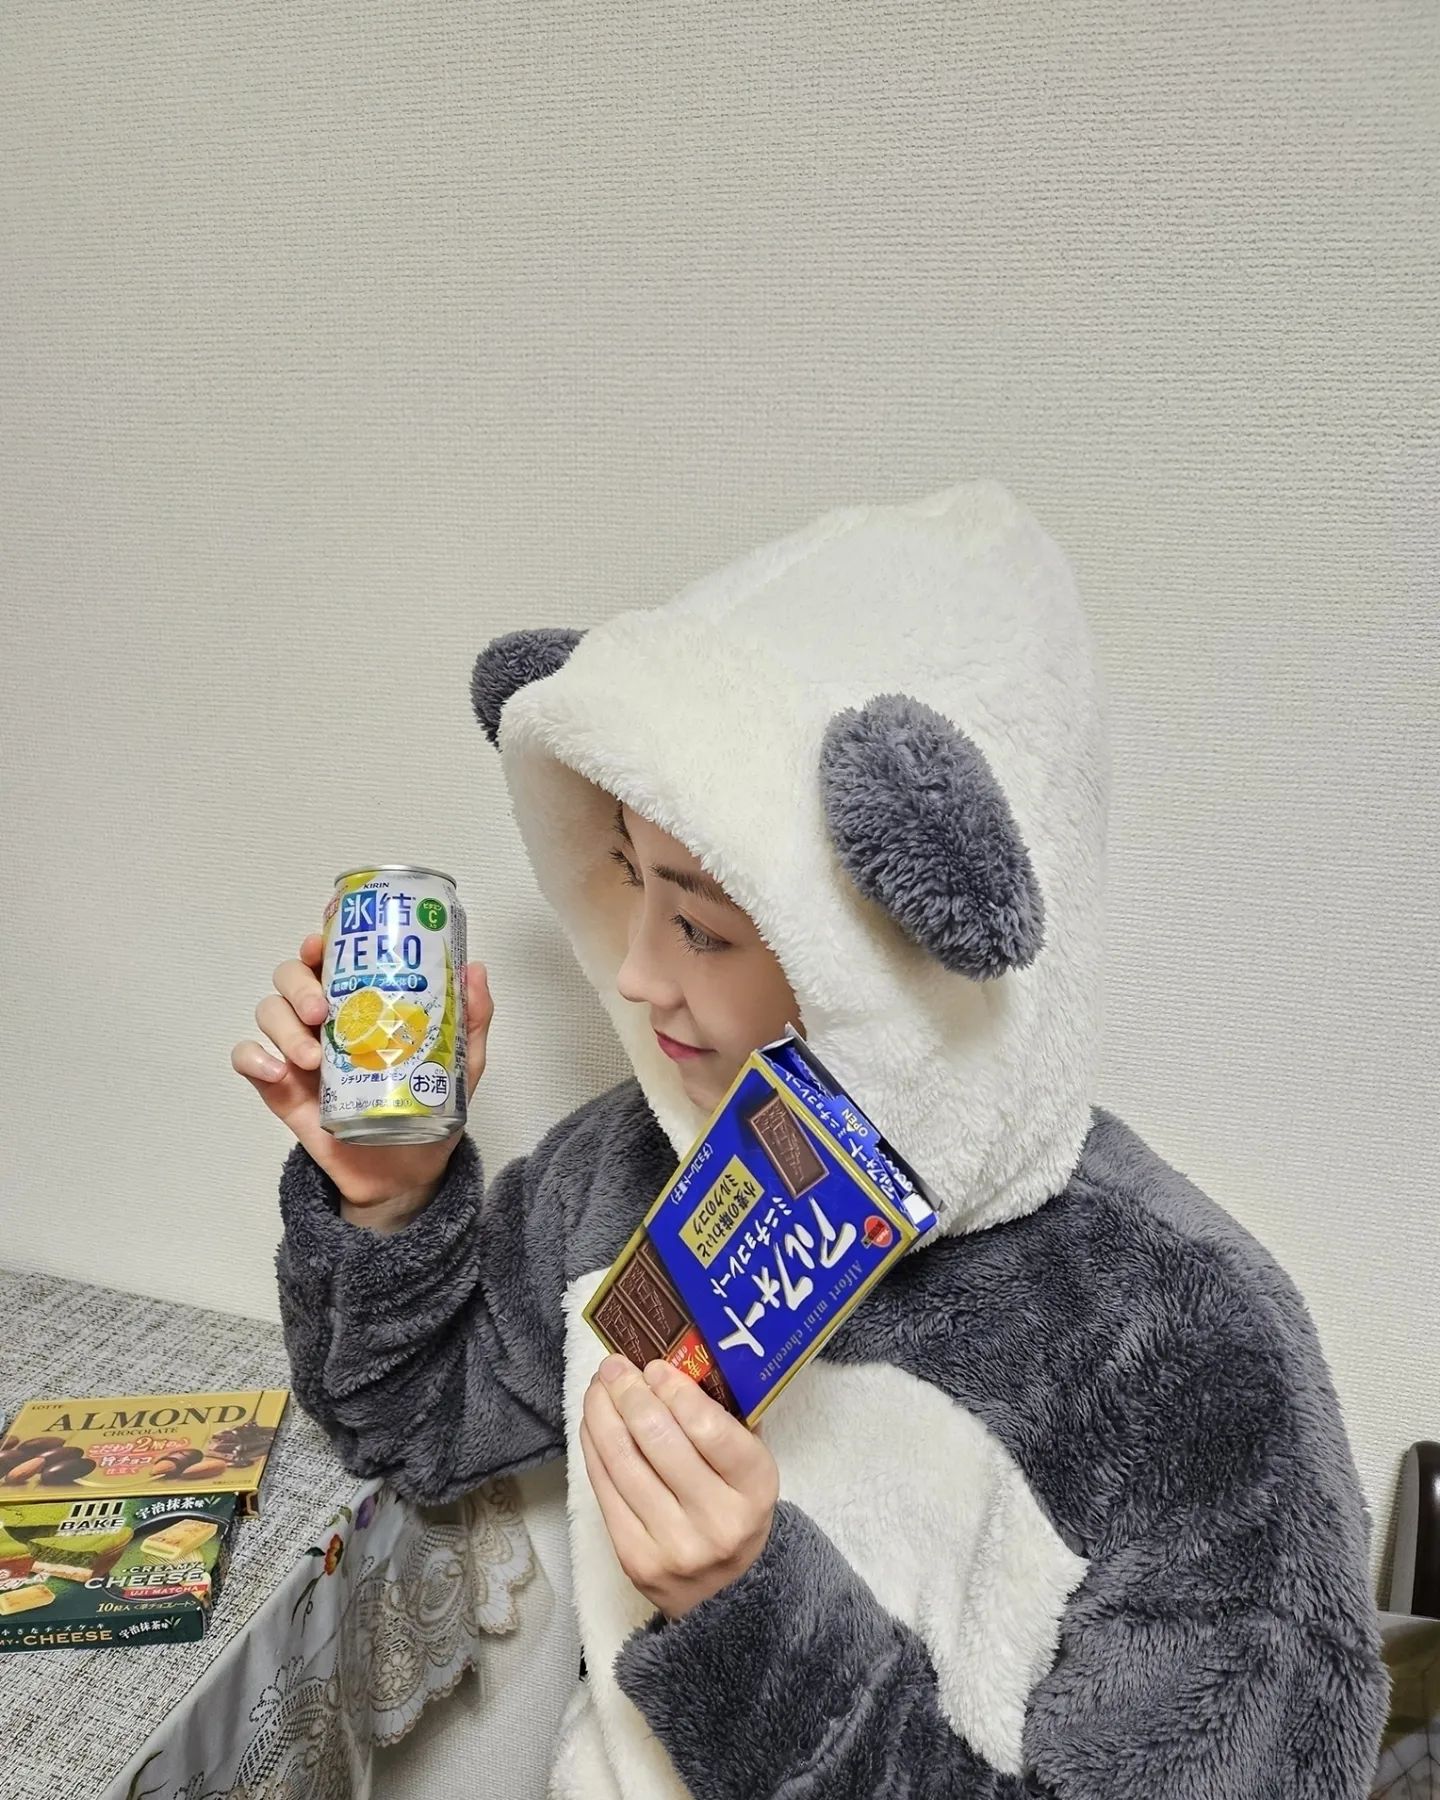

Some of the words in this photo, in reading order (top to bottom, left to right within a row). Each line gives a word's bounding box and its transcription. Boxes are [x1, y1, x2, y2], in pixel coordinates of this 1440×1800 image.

[363, 882, 390, 890] KIRIN
[333, 934, 422, 976] ZERO
[413, 1074, 447, 1095] お酒
[841, 1107, 869, 1138] OPEN
[694, 1175, 739, 1234] ミルクのコク
[700, 1182, 756, 1257] 小麦の味わいと
[711, 1197, 793, 1298] ミニチョコレート
[717, 1196, 858, 1358] アルフォート
[829, 1261, 863, 1300] Alfort
[803, 1300, 828, 1332] mini
[759, 1330, 803, 1382] chocolate
[42, 1405, 248, 1433] ALMOND
[102, 1427, 179, 1438] CHOCOLATE
[60, 1519, 124, 1531] BAKE
[84, 1570, 204, 1590] CHEESE
[151, 1586, 199, 1595] MATCHA
[23, 1630, 113, 1647] CHEESE
